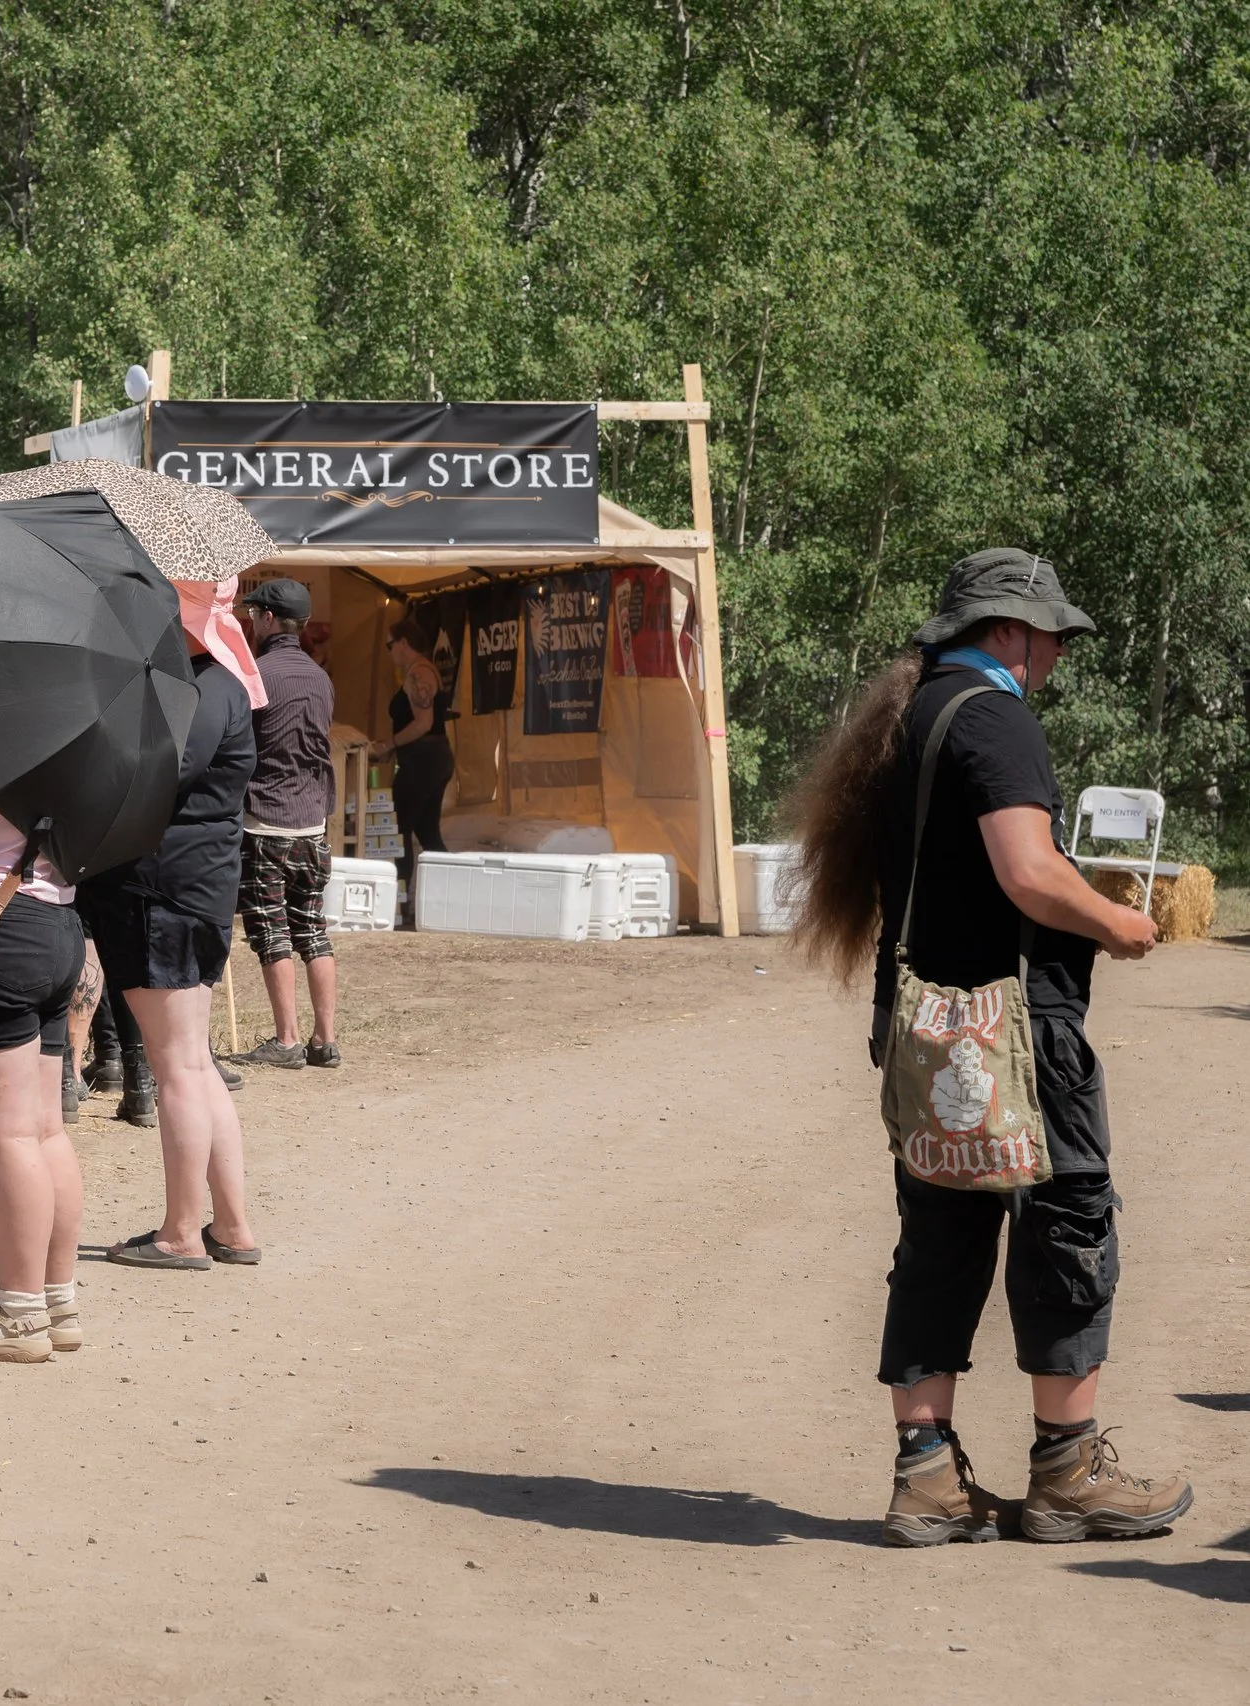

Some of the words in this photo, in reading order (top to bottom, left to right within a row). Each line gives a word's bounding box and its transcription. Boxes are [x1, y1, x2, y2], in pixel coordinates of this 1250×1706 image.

[156, 451, 407, 488] GENERAL
[428, 453, 594, 489] STORE
[550, 591, 580, 618] BEST
[1099, 808, 1113, 816] NO
[1114, 809, 1142, 817] ENTRY
[903, 1126, 1037, 1178] Count
